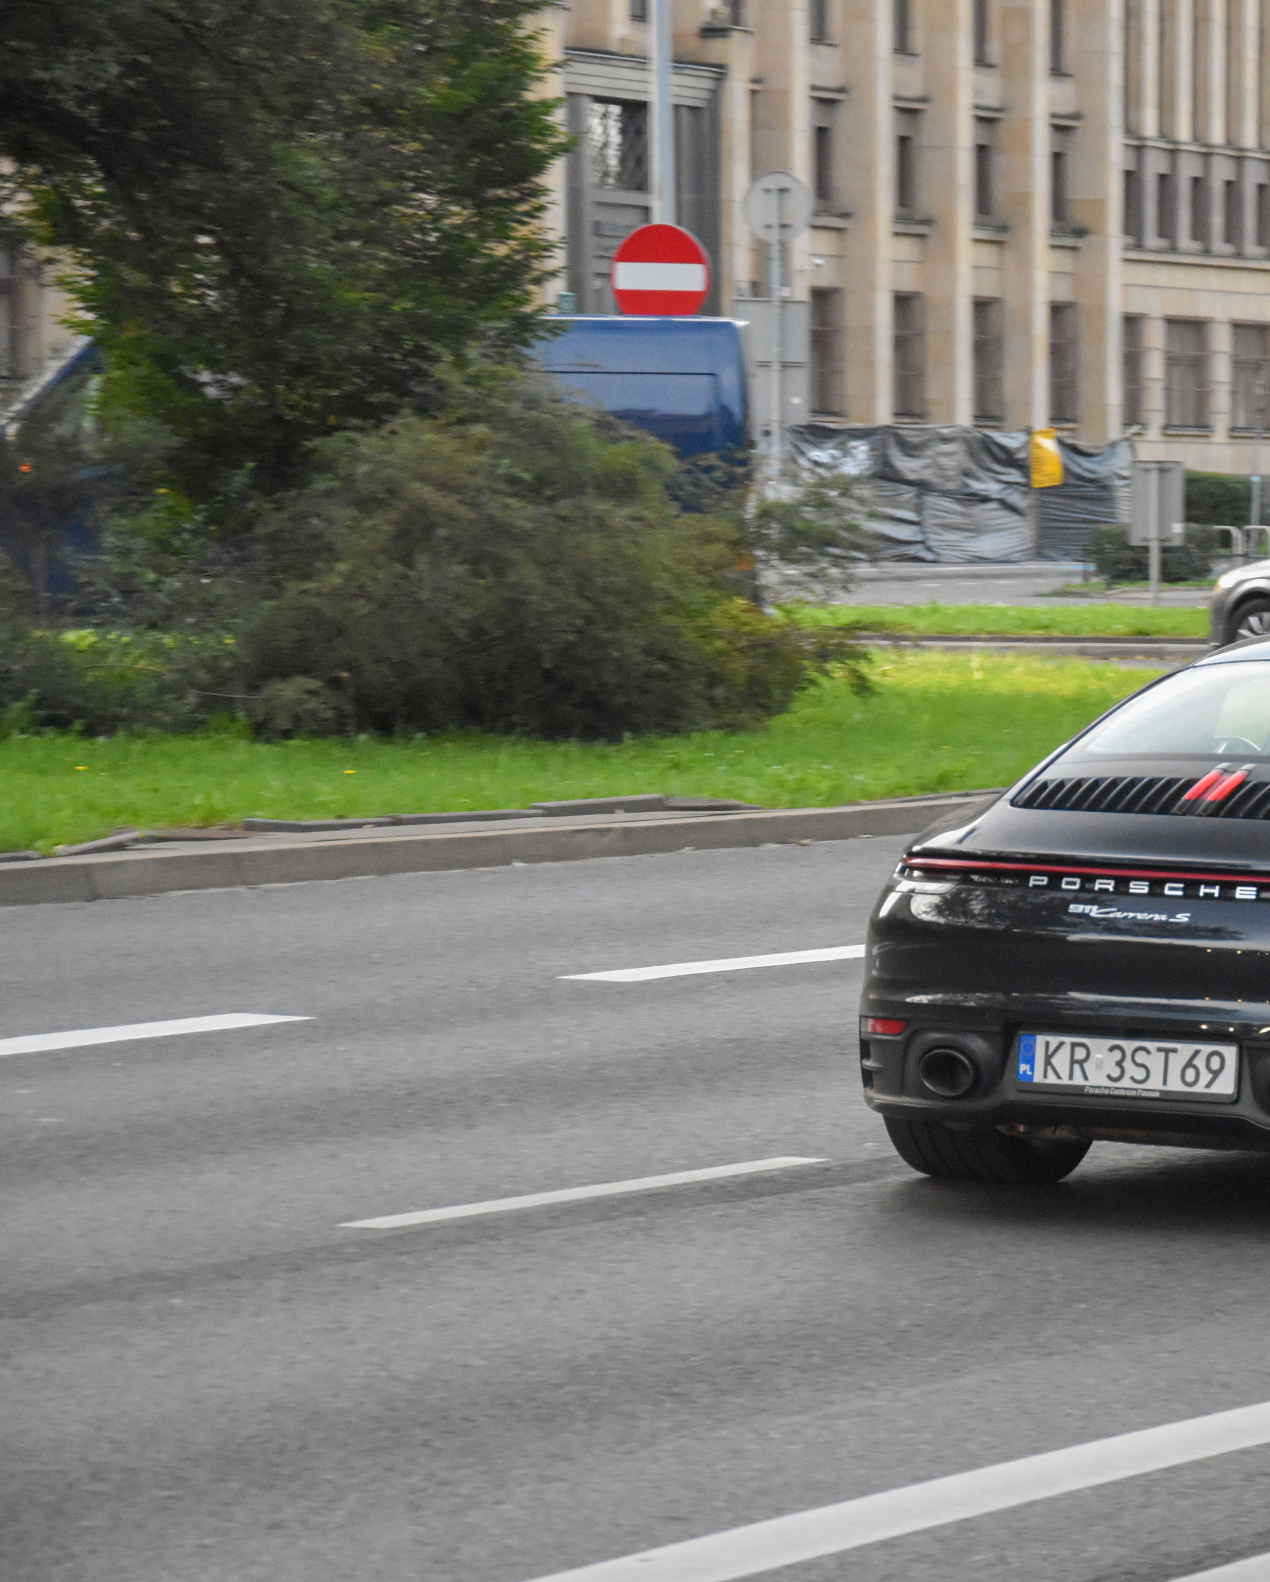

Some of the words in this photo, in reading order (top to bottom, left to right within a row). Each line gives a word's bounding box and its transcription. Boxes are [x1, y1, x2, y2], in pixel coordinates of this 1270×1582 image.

[1029, 875, 1258, 900] PORSCHE
[1090, 908, 1168, 921] Carrera
[1169, 913, 1192, 922] S
[1019, 1064, 1033, 1076] PL
[1042, 1040, 1092, 1082] KR
[1106, 1043, 1227, 1090] 3ST69
[1084, 1085, 1110, 1095] Porsche
